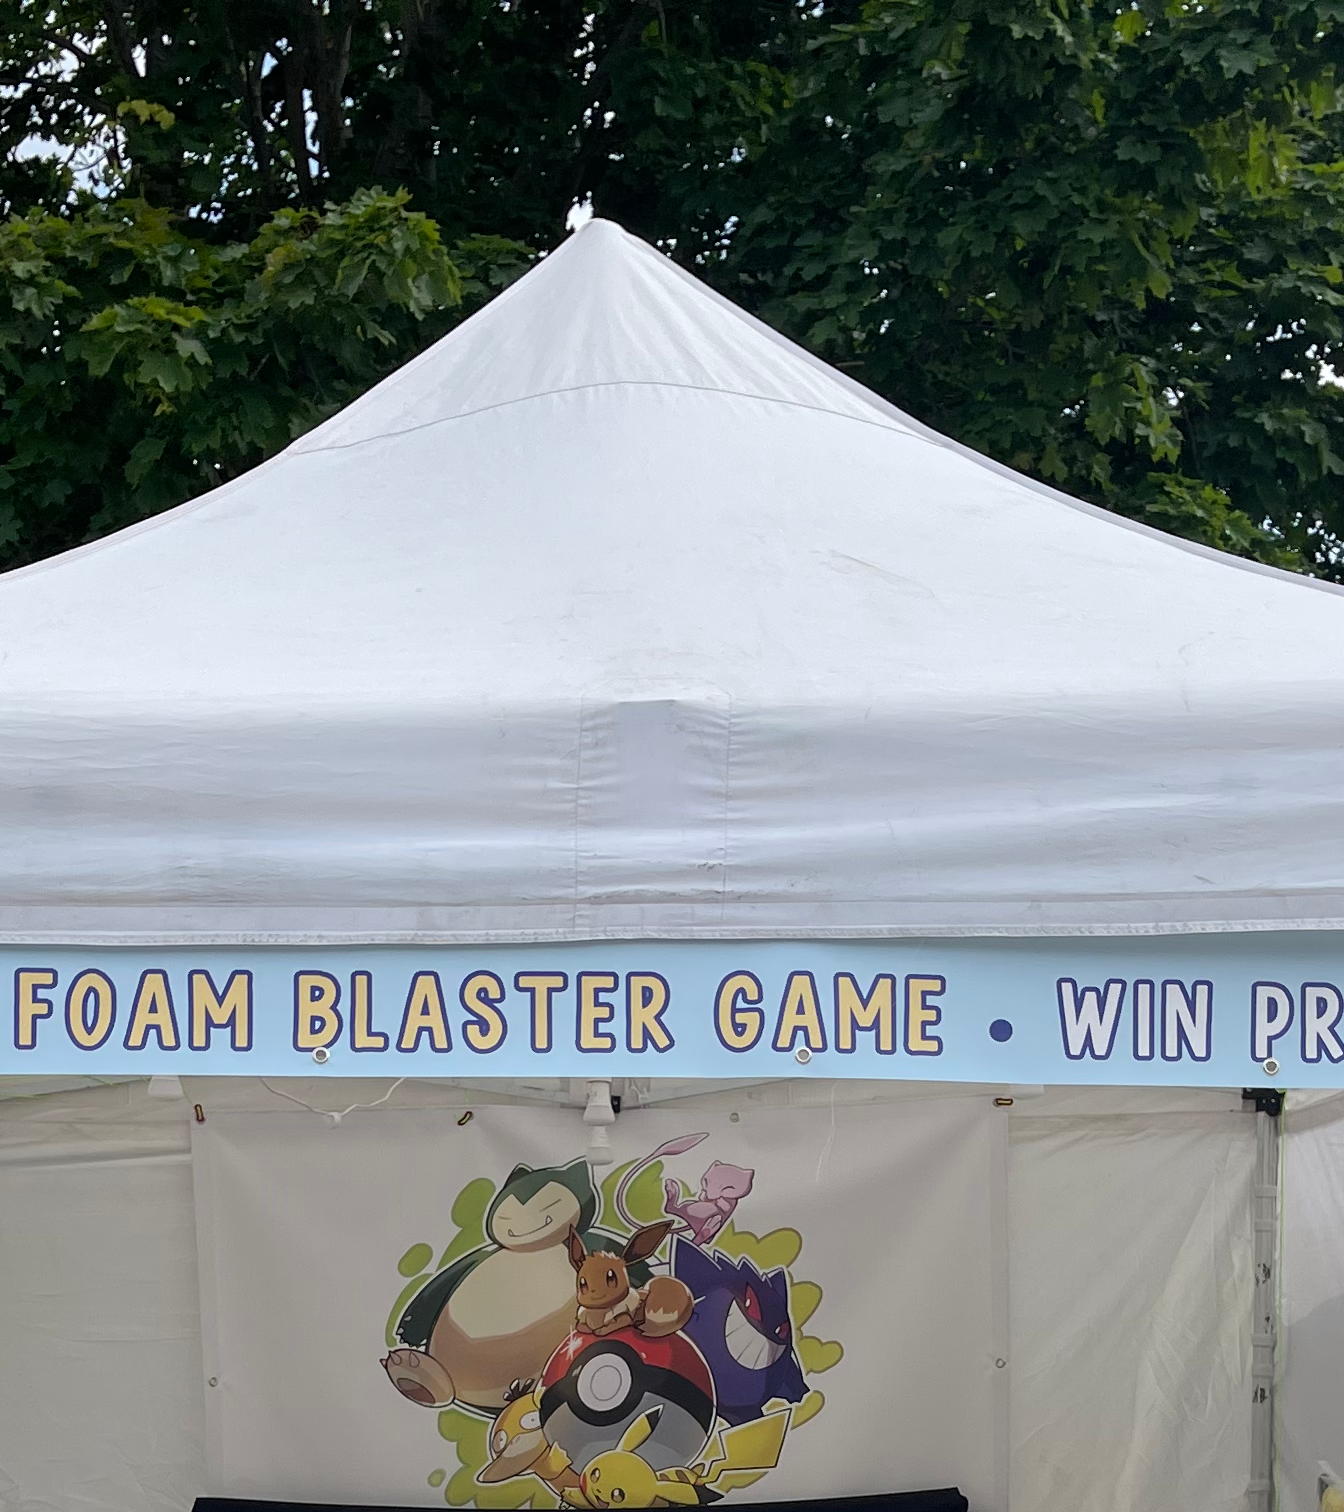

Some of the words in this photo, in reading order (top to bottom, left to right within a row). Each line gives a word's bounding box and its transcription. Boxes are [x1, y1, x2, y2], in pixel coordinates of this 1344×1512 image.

[13, 967, 254, 1053] FOAM
[293, 968, 675, 1056] BLASTER
[713, 970, 946, 1056] GAME
[1055, 976, 1213, 1063] WIN
